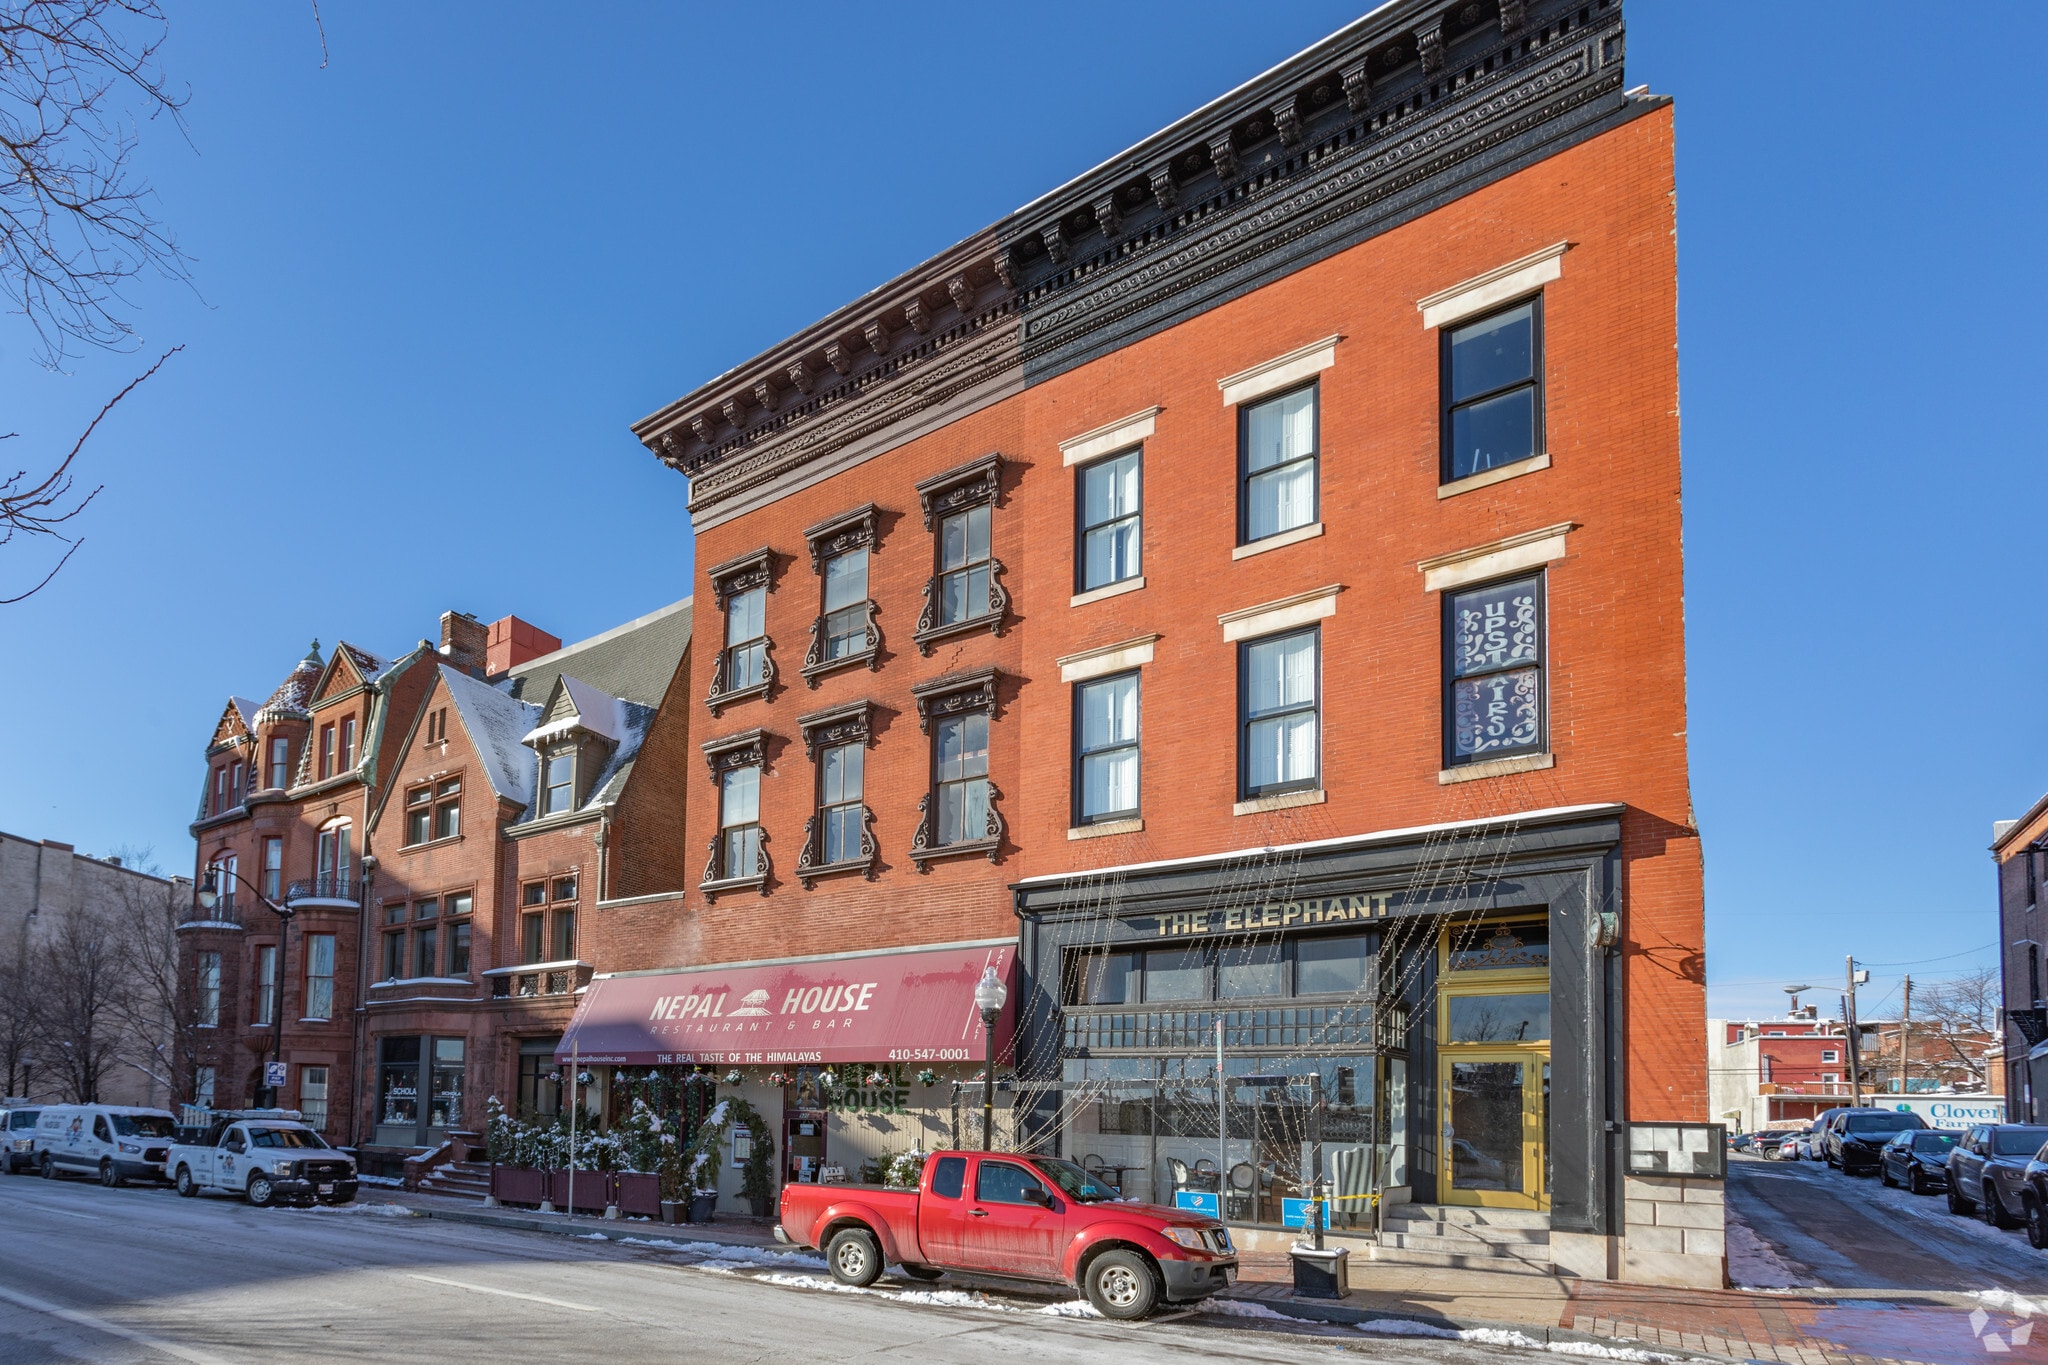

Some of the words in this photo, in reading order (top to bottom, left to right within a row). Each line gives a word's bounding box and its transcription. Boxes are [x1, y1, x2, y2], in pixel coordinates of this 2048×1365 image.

[1484, 601, 1508, 736] UPSTAIRS
[1154, 911, 1209, 936] THE
[1225, 893, 1393, 930] ELEPHANT
[649, 992, 727, 1021] NEPAL
[780, 983, 878, 1014] HOUSE
[650, 1021, 772, 1035] RESTAURANT
[787, 1020, 796, 1030] &
[812, 1018, 853, 1030] BAR
[562, 1054, 627, 1064] wwwnepalhouseinc.com
[657, 1054, 672, 1063] THE
[676, 1053, 696, 1063] REAL
[700, 1053, 724, 1062] TASTE
[729, 1053, 741, 1062] OF
[745, 1052, 762, 1062] THE
[767, 1052, 822, 1062] HIMALAYAS
[888, 1048, 970, 1060] 410-547-0001
[393, 1087, 417, 1095] SCHOLA
